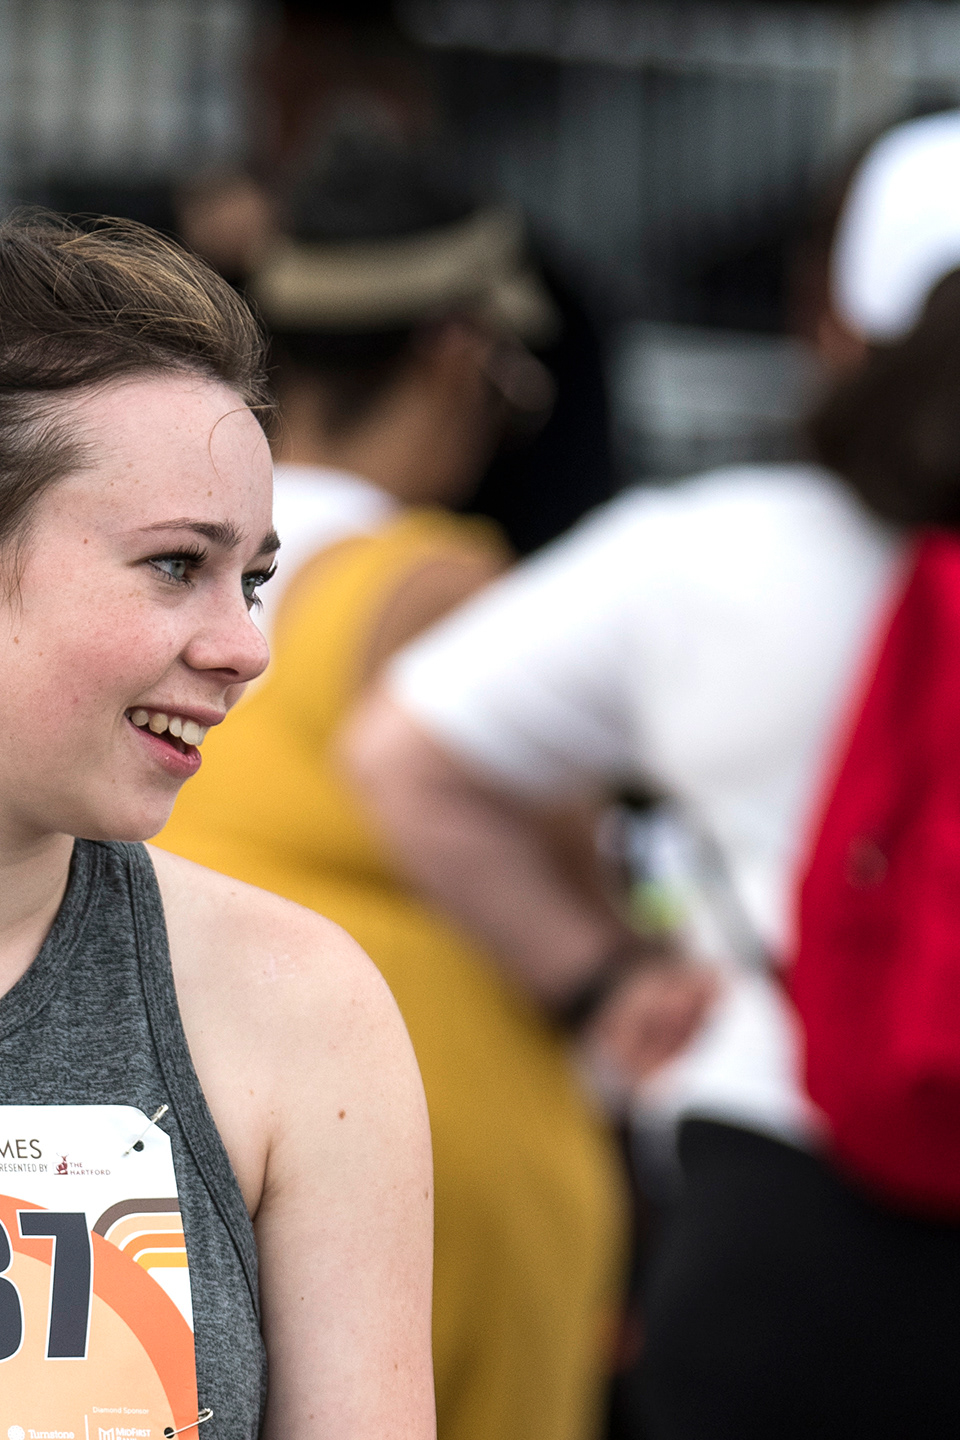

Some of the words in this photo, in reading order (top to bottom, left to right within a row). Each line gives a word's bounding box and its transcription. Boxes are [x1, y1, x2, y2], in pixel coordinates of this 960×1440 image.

[39, 1163, 48, 1173] BY
[92, 1406, 122, 1414] Diamond
[123, 1406, 150, 1415] Sponsor
